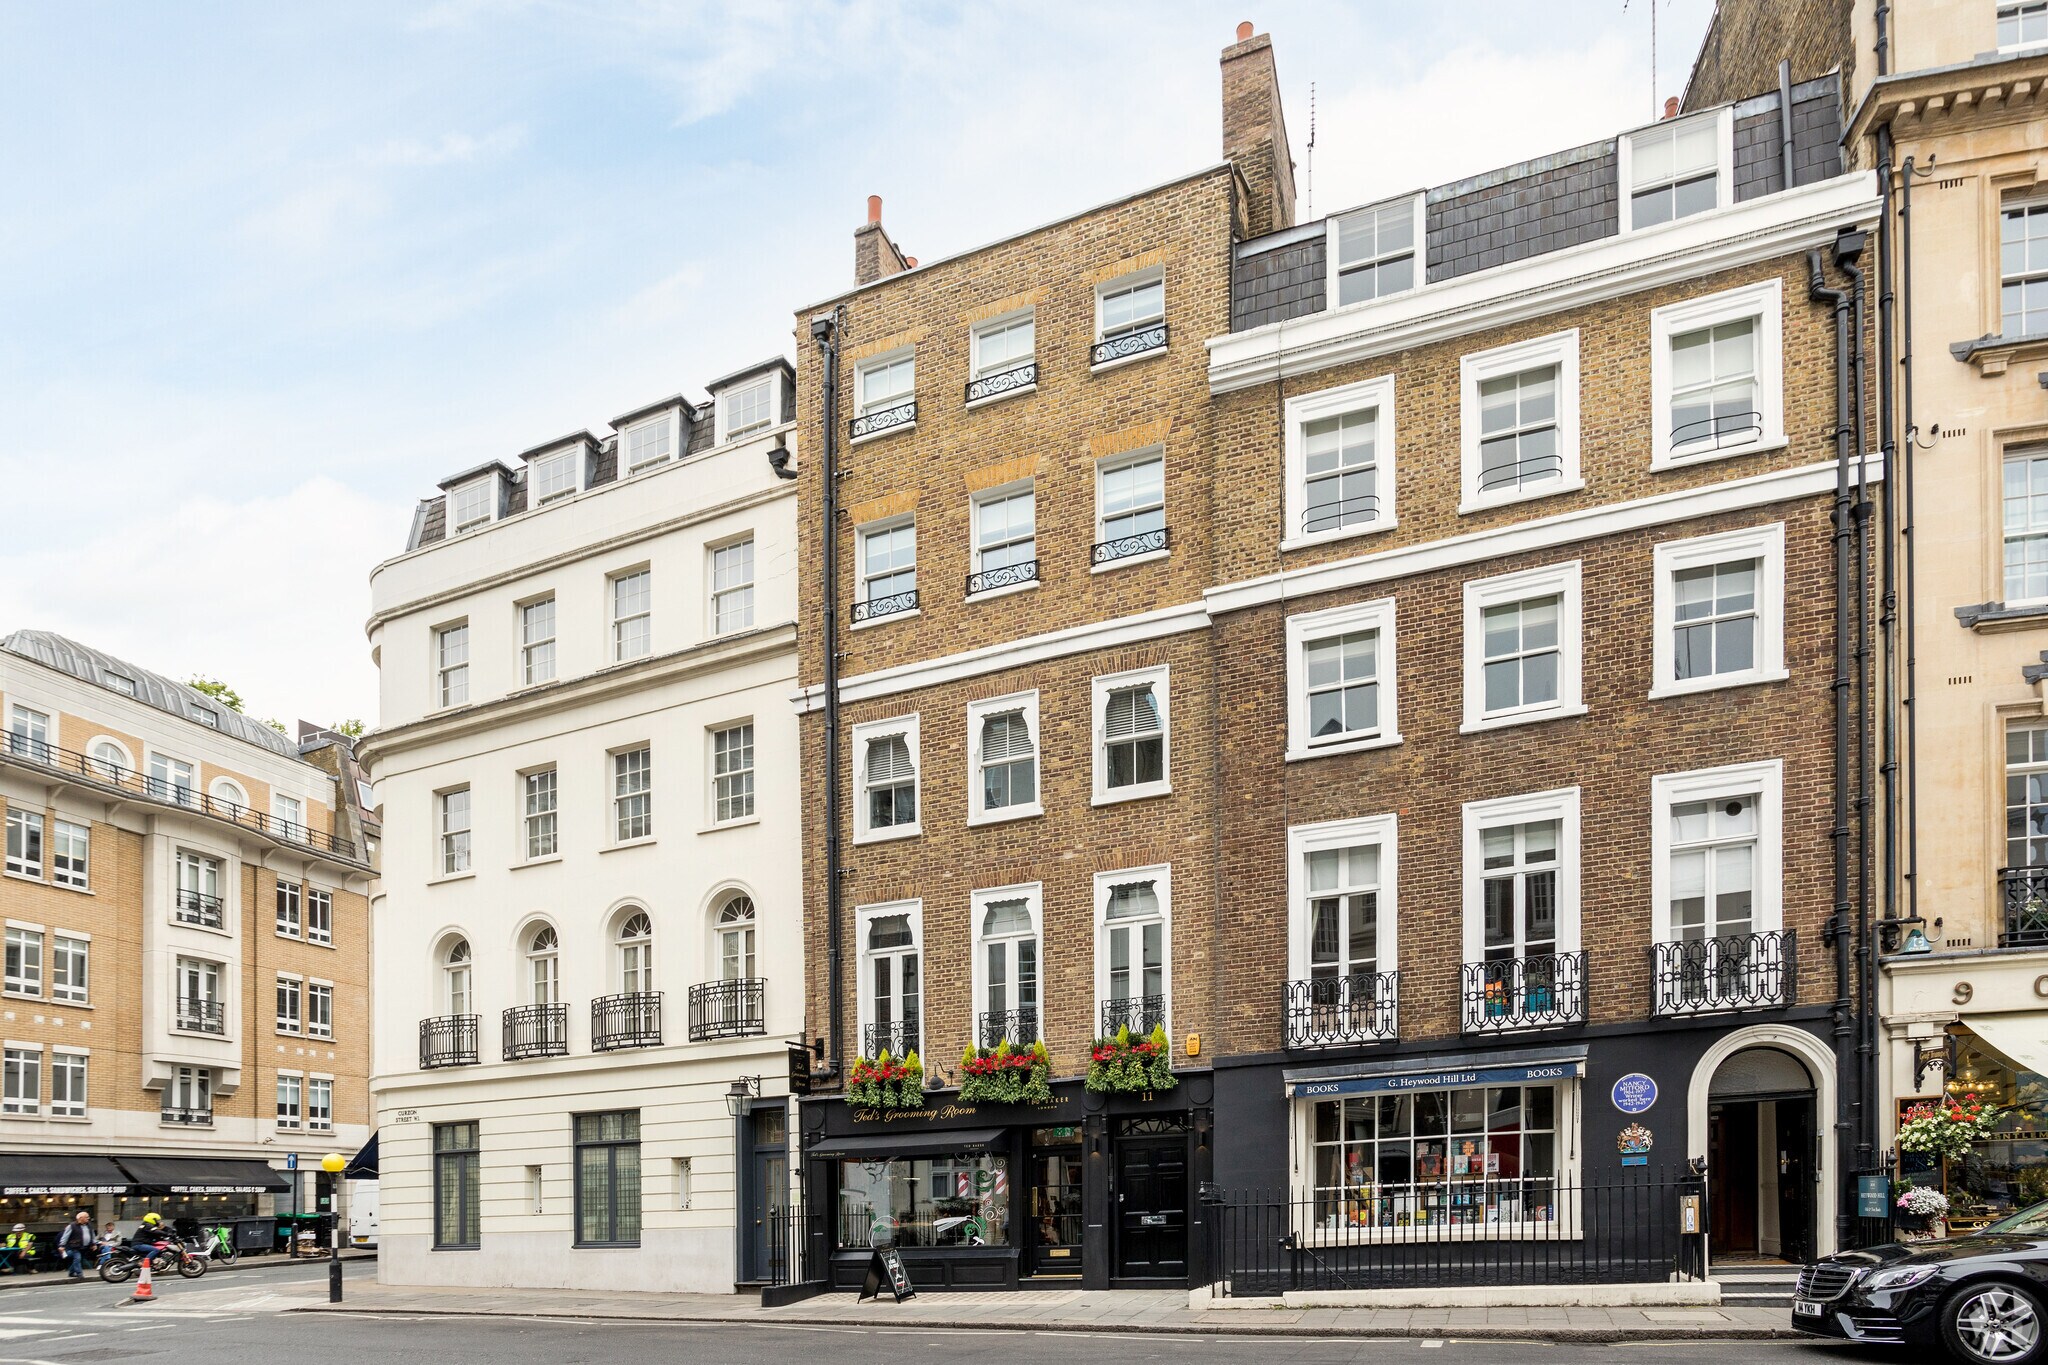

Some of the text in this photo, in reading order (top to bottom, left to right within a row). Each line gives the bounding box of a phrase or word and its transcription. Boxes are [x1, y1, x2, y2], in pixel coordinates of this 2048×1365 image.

[1952, 981, 1973, 1005] 9
[1527, 1067, 1563, 1078] BOOKS
[1388, 1073, 1476, 1088] G. Heywood Hill Ltd
[1306, 1084, 1339, 1094] BOOKS
[1141, 1091, 1153, 1101] 11
[853, 1104, 976, 1123] Ted's Grooming Room
